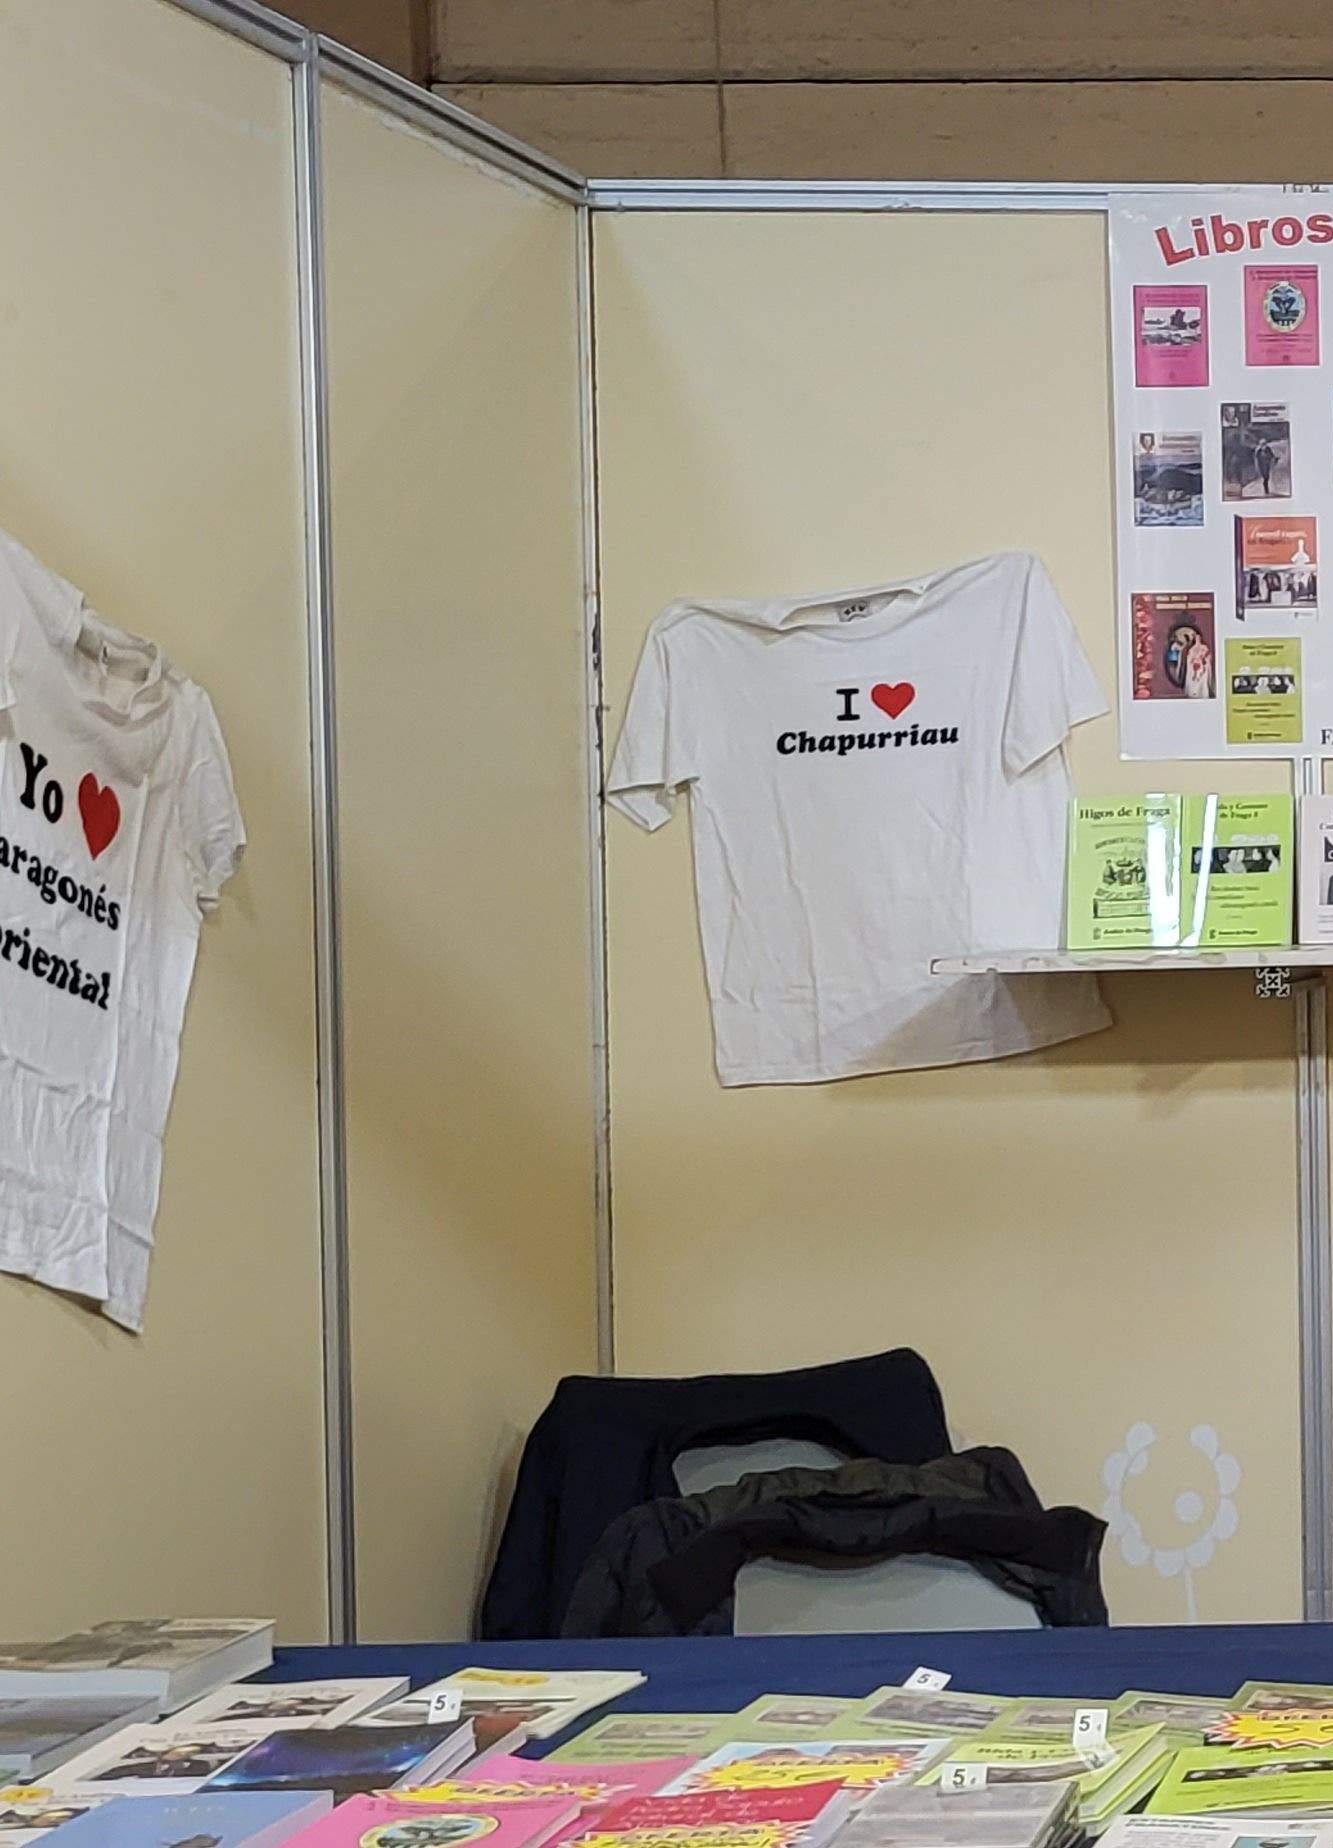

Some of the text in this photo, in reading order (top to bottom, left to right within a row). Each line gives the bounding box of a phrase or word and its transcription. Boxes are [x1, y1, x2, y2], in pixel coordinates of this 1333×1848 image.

[836, 688, 860, 721] I
[777, 724, 959, 756] Chapurriau
[20, 742, 63, 823] Yo
[1081, 809, 1114, 820] Higos
[1118, 807, 1132, 817] de
[0, 925, 111, 1010] riental
